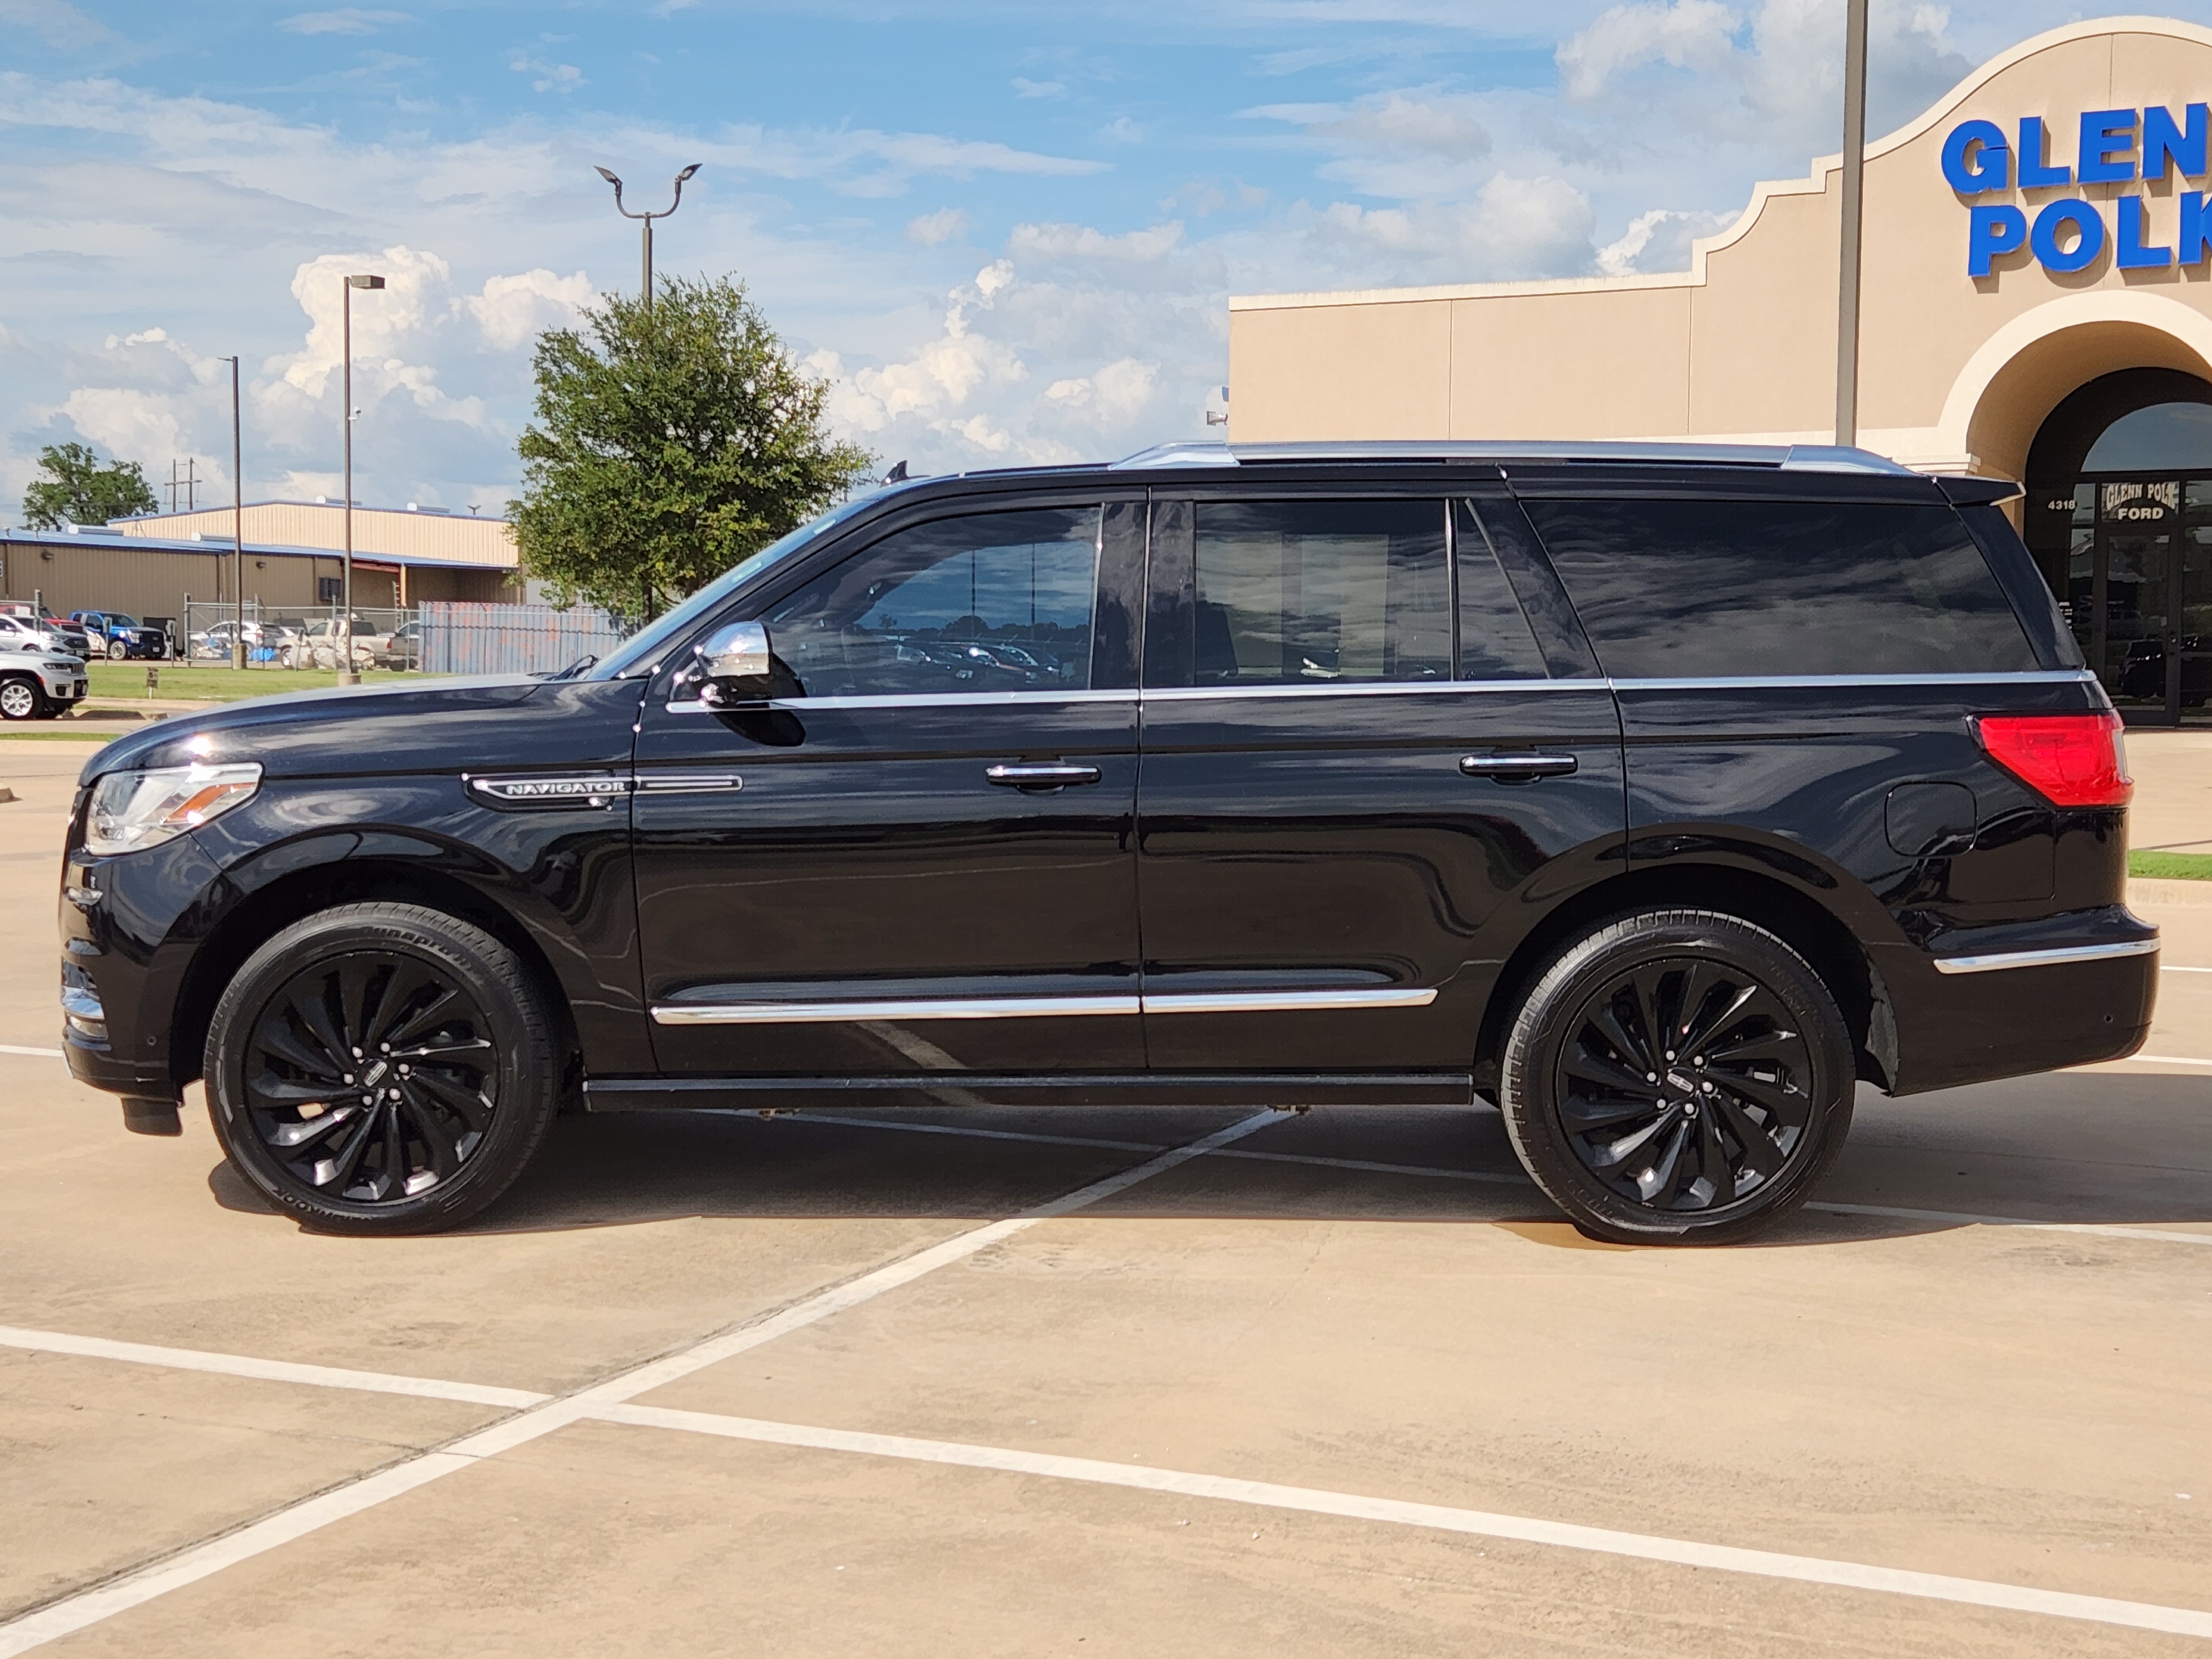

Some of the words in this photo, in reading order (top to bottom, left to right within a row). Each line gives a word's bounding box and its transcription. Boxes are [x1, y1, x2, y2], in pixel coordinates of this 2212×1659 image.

[1941, 102, 2208, 195] GLEN
[2106, 483, 2143, 512] GLENN
[2147, 482, 2176, 510] POLK
[2048, 500, 2075, 510] 4318
[2118, 507, 2164, 520] FORD
[506, 782, 625, 795] NAVIGATOR
